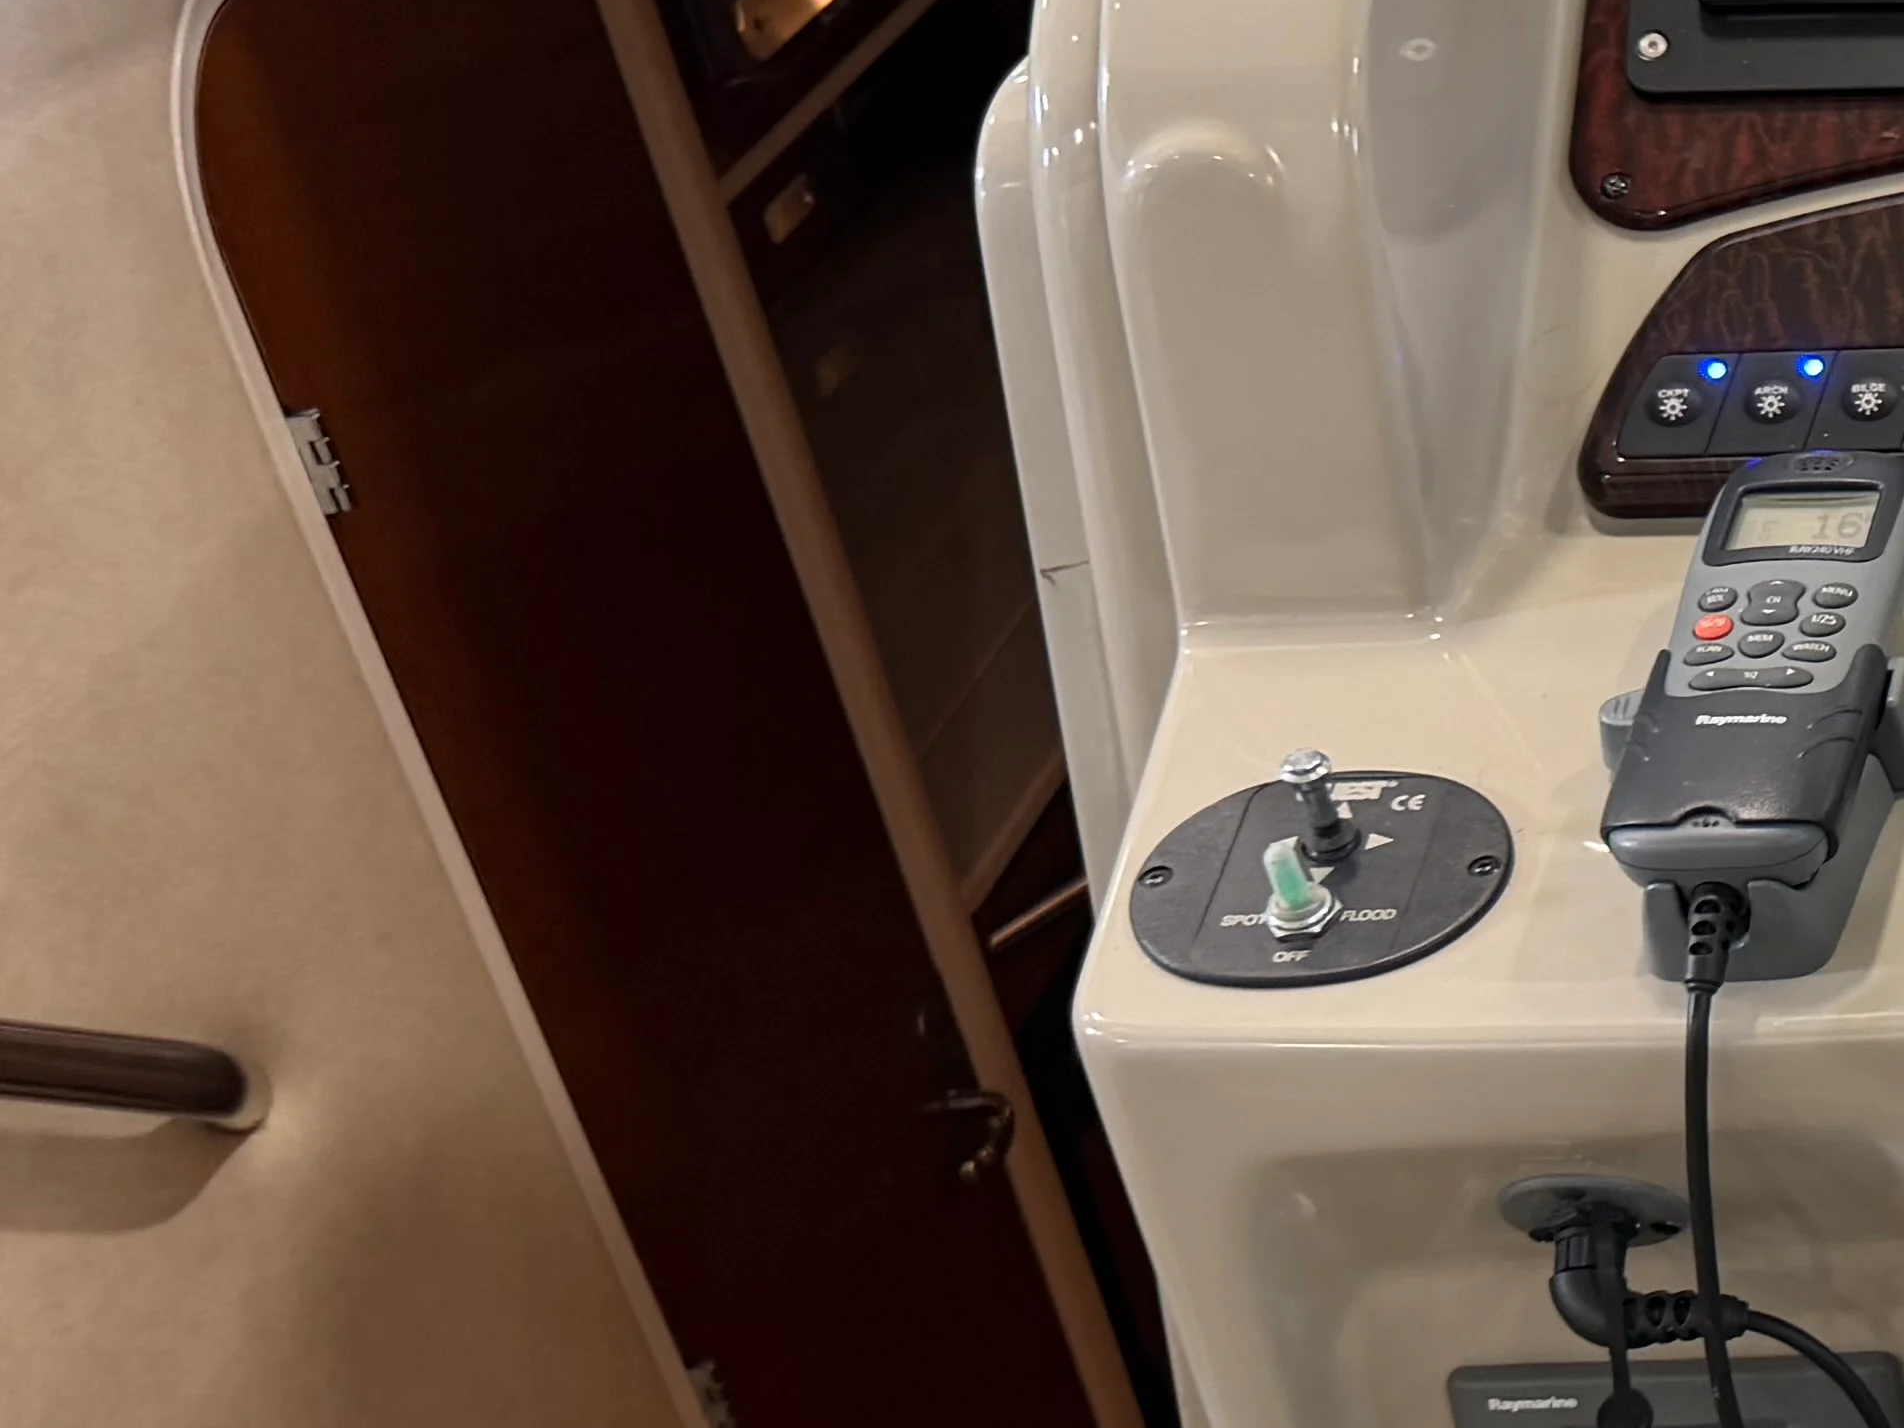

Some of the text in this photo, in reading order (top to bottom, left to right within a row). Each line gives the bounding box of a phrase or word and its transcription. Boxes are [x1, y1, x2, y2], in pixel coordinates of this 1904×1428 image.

[1657, 388, 1690, 399] CKPT
[1754, 385, 1789, 396] ARCH
[1851, 382, 1887, 394] BILGE
[1812, 512, 1864, 540] 16
[1822, 587, 1853, 597] MENU
[1766, 596, 1781, 604] CH
[1811, 614, 1837, 625] 1/25
[1747, 634, 1774, 643] MEM
[1793, 644, 1830, 652] WATCH
[1696, 714, 1787, 726] Raymarine
[1391, 794, 1426, 811] CE
[1220, 913, 1266, 926] SPOT
[1340, 909, 1397, 922] FLOOD
[1272, 950, 1311, 962] OFF
[1488, 1395, 1578, 1413] Raymarine
